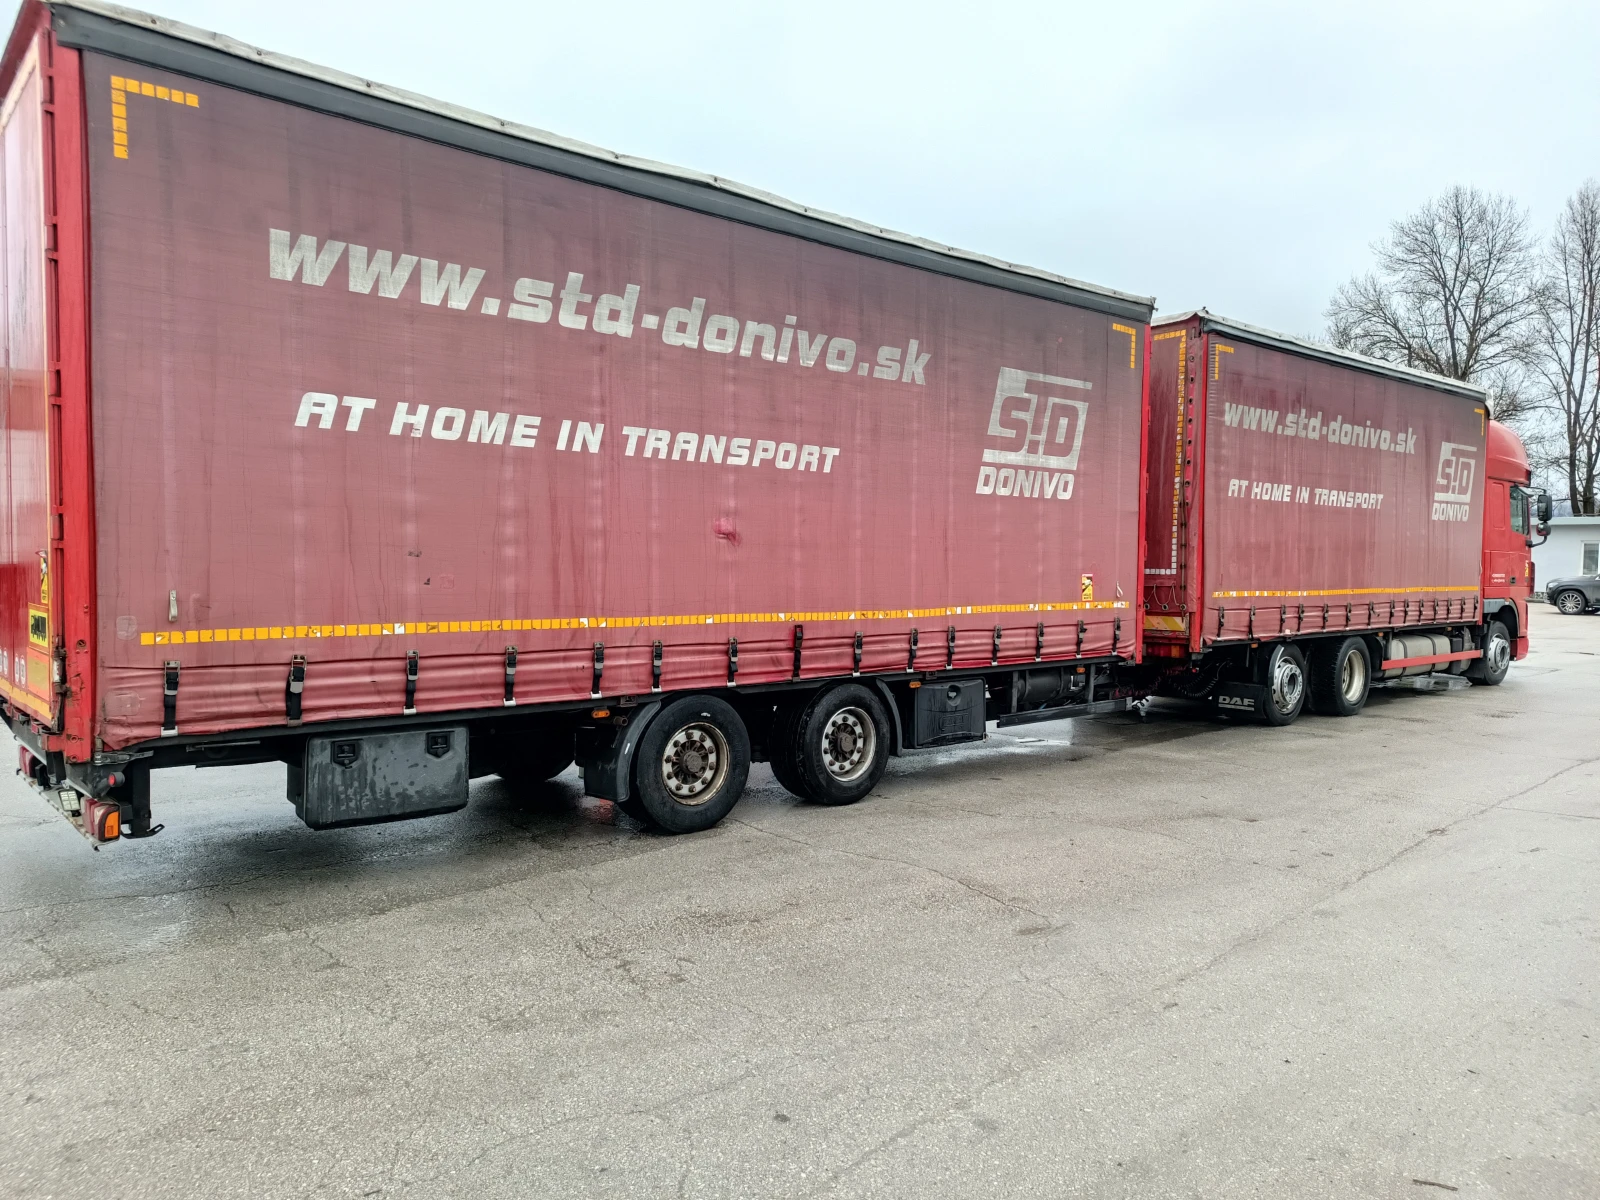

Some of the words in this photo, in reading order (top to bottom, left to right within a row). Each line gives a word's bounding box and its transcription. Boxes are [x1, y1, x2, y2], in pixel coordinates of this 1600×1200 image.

[268, 228, 931, 386] www.std-donivo.sk
[294, 391, 376, 432] AT
[389, 402, 541, 448] HOME
[556, 420, 605, 454] IN
[622, 426, 840, 474] TRANSPORT
[1224, 402, 1417, 454] www.std-donivo.sk
[976, 466, 1075, 500] DONIVO
[1228, 479, 1248, 498] AT
[1251, 482, 1292, 502] HOME
[1295, 486, 1310, 504] IN
[1314, 488, 1383, 509] TRANSPORT
[1432, 502, 1470, 522] DONIVO
[1218, 695, 1254, 705] DAF
